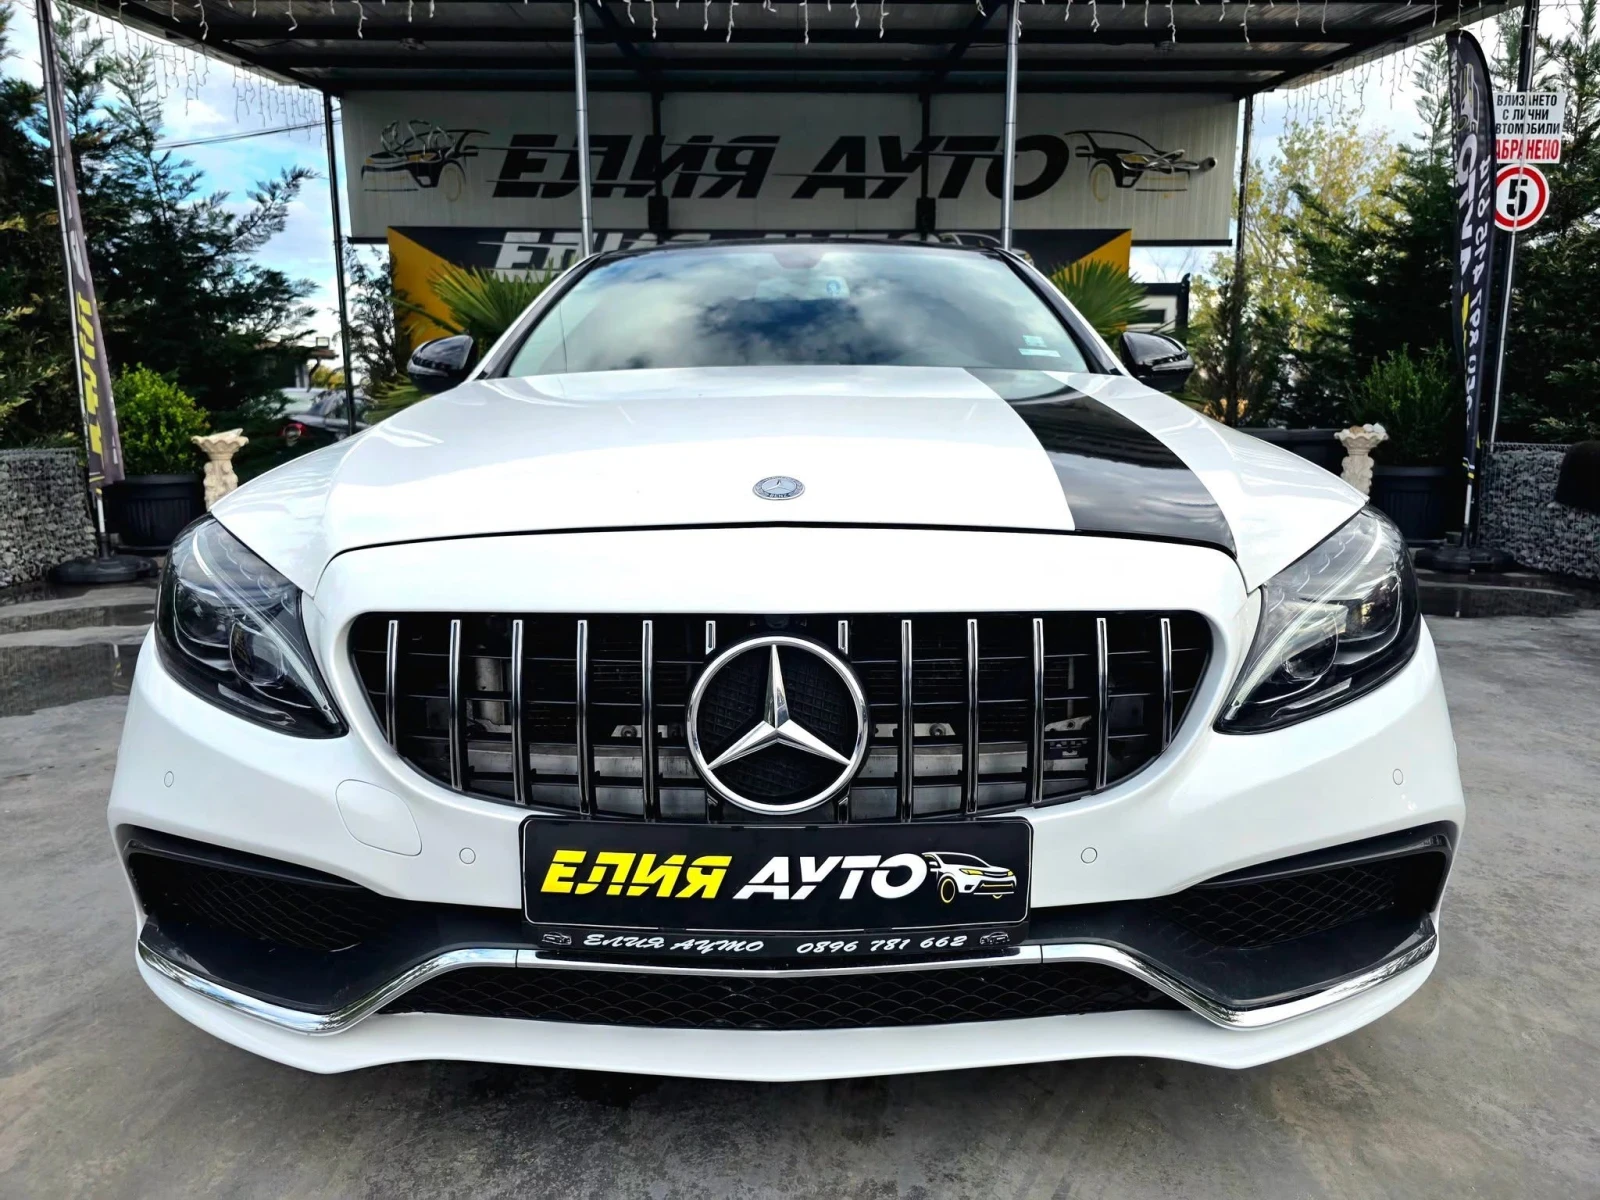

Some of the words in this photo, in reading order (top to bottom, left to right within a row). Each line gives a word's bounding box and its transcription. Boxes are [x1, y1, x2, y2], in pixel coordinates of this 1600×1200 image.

[1502, 109, 1509, 120] С
[1496, 139, 1559, 159] АБРАНЕНО
[493, 134, 780, 199] ЕЛИЯ
[791, 134, 1069, 200] АУТО
[1506, 178, 1528, 216] 5
[541, 850, 732, 899] ЕЛИЯ
[732, 853, 927, 900] АУТО
[796, 941, 859, 954] 0896
[870, 939, 911, 951] 781
[920, 935, 967, 949] 662
